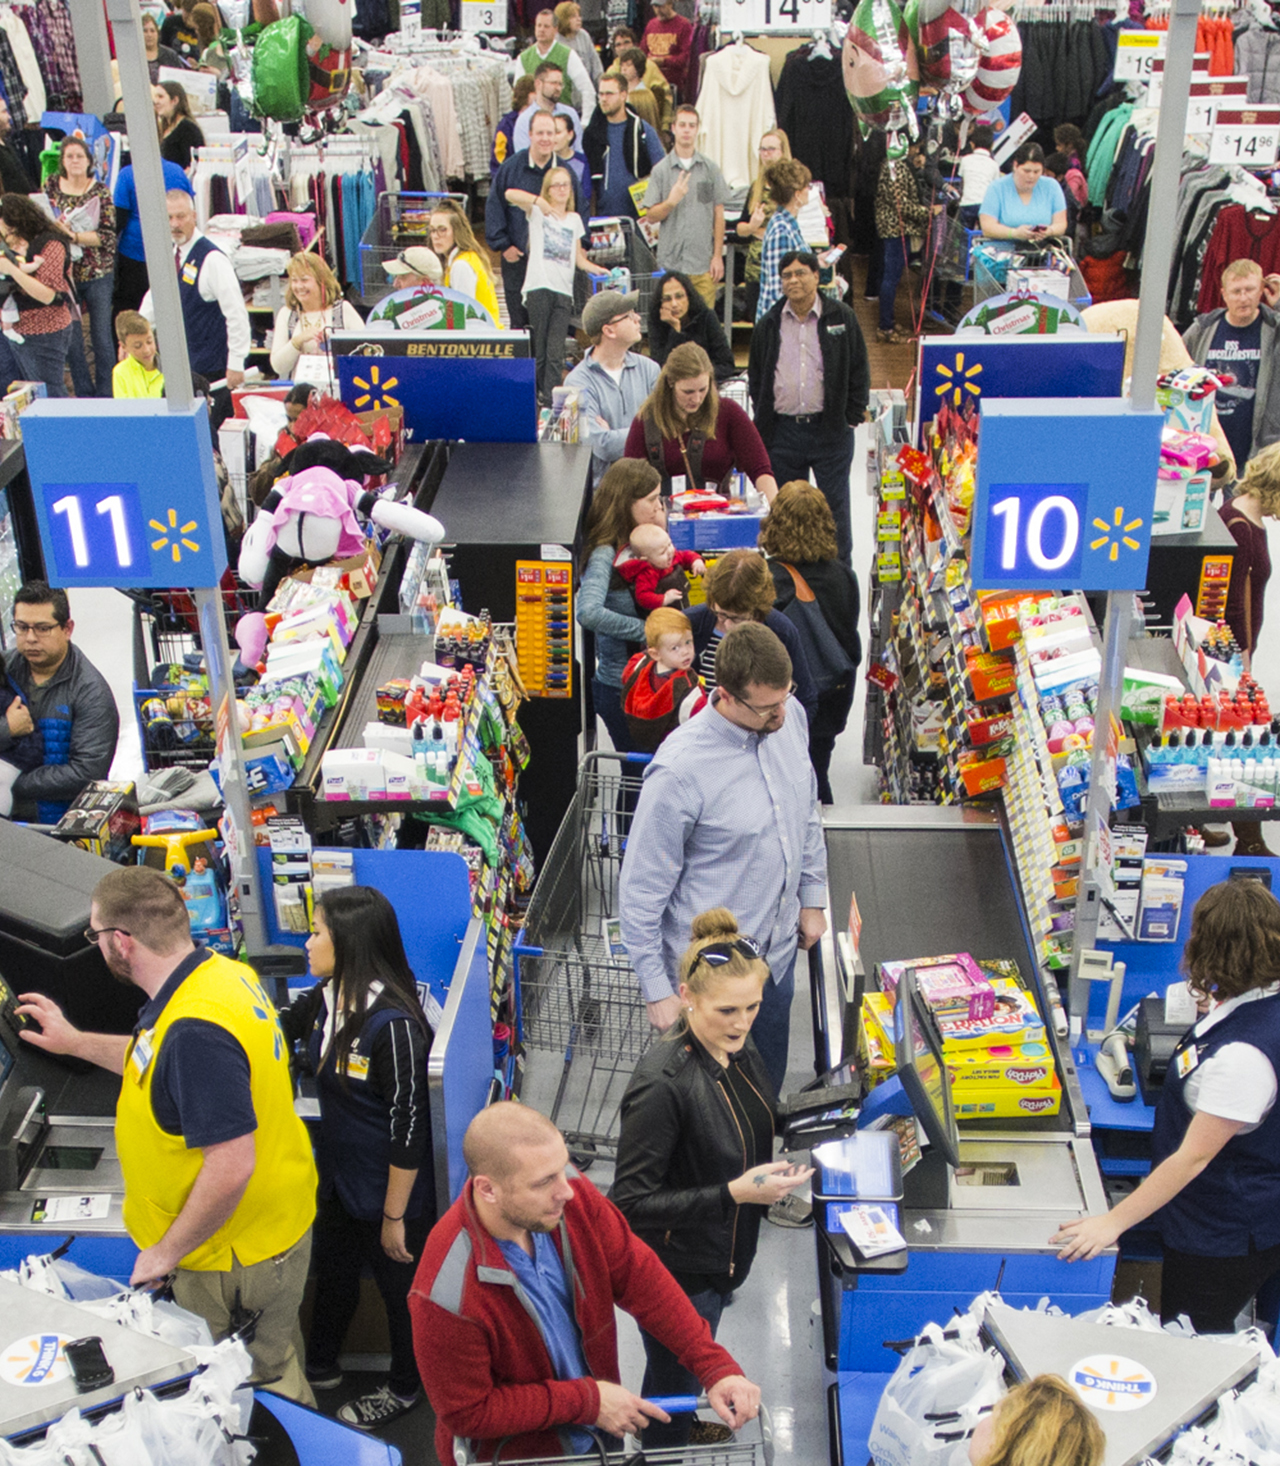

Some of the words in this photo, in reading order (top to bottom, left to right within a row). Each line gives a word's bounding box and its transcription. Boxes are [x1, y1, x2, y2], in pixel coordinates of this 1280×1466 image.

[407, 342, 515, 357] BENTONVILLE
[52, 495, 132, 568] 11
[992, 495, 1079, 571] 10
